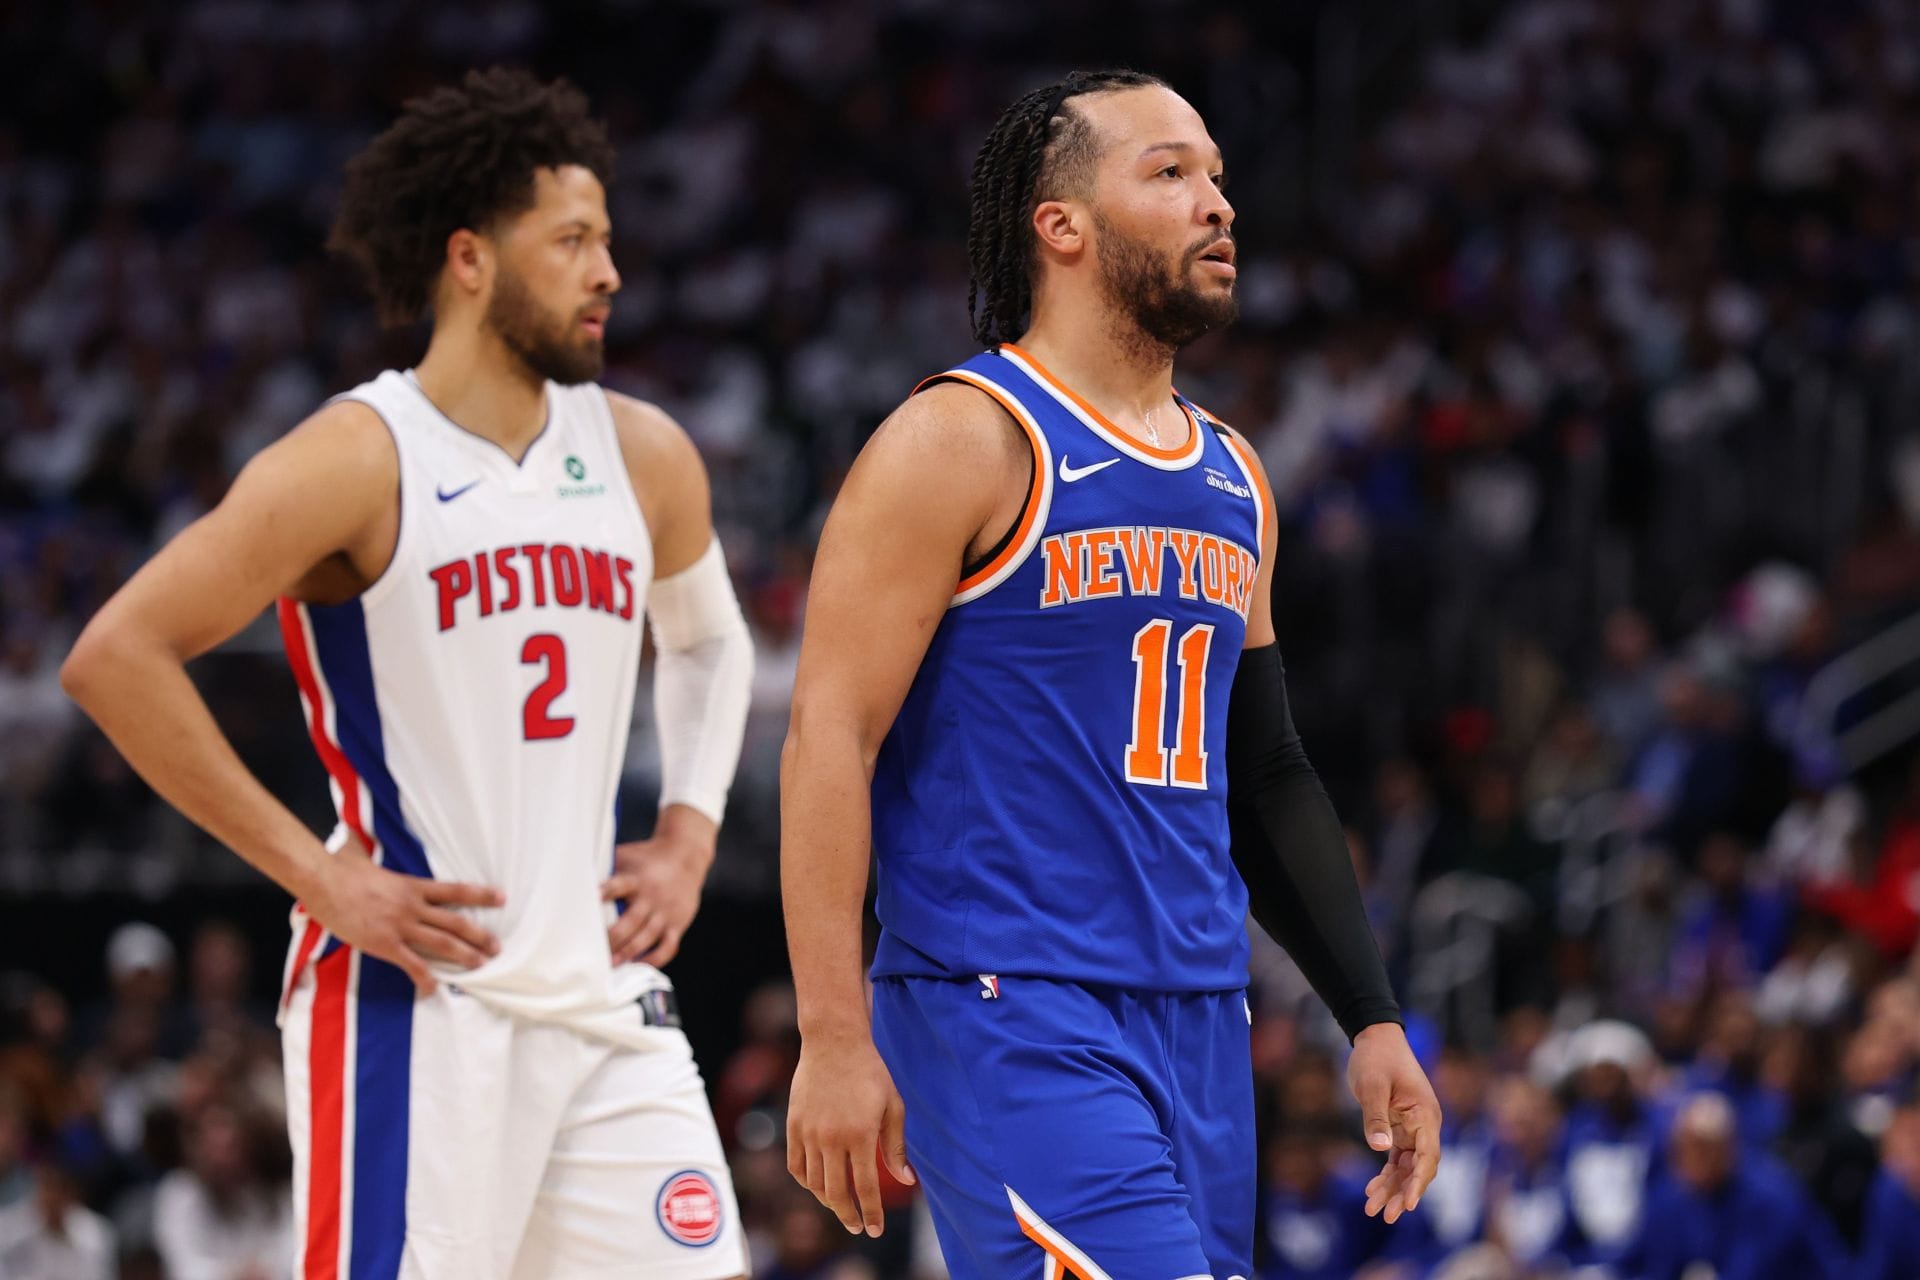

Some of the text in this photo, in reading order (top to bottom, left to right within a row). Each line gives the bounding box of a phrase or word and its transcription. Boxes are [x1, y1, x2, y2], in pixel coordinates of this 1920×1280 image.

[428, 542, 635, 633] PISTONS
[1040, 525, 1166, 609] NEW
[520, 632, 576, 742] 2
[1124, 618, 1215, 790] 11
